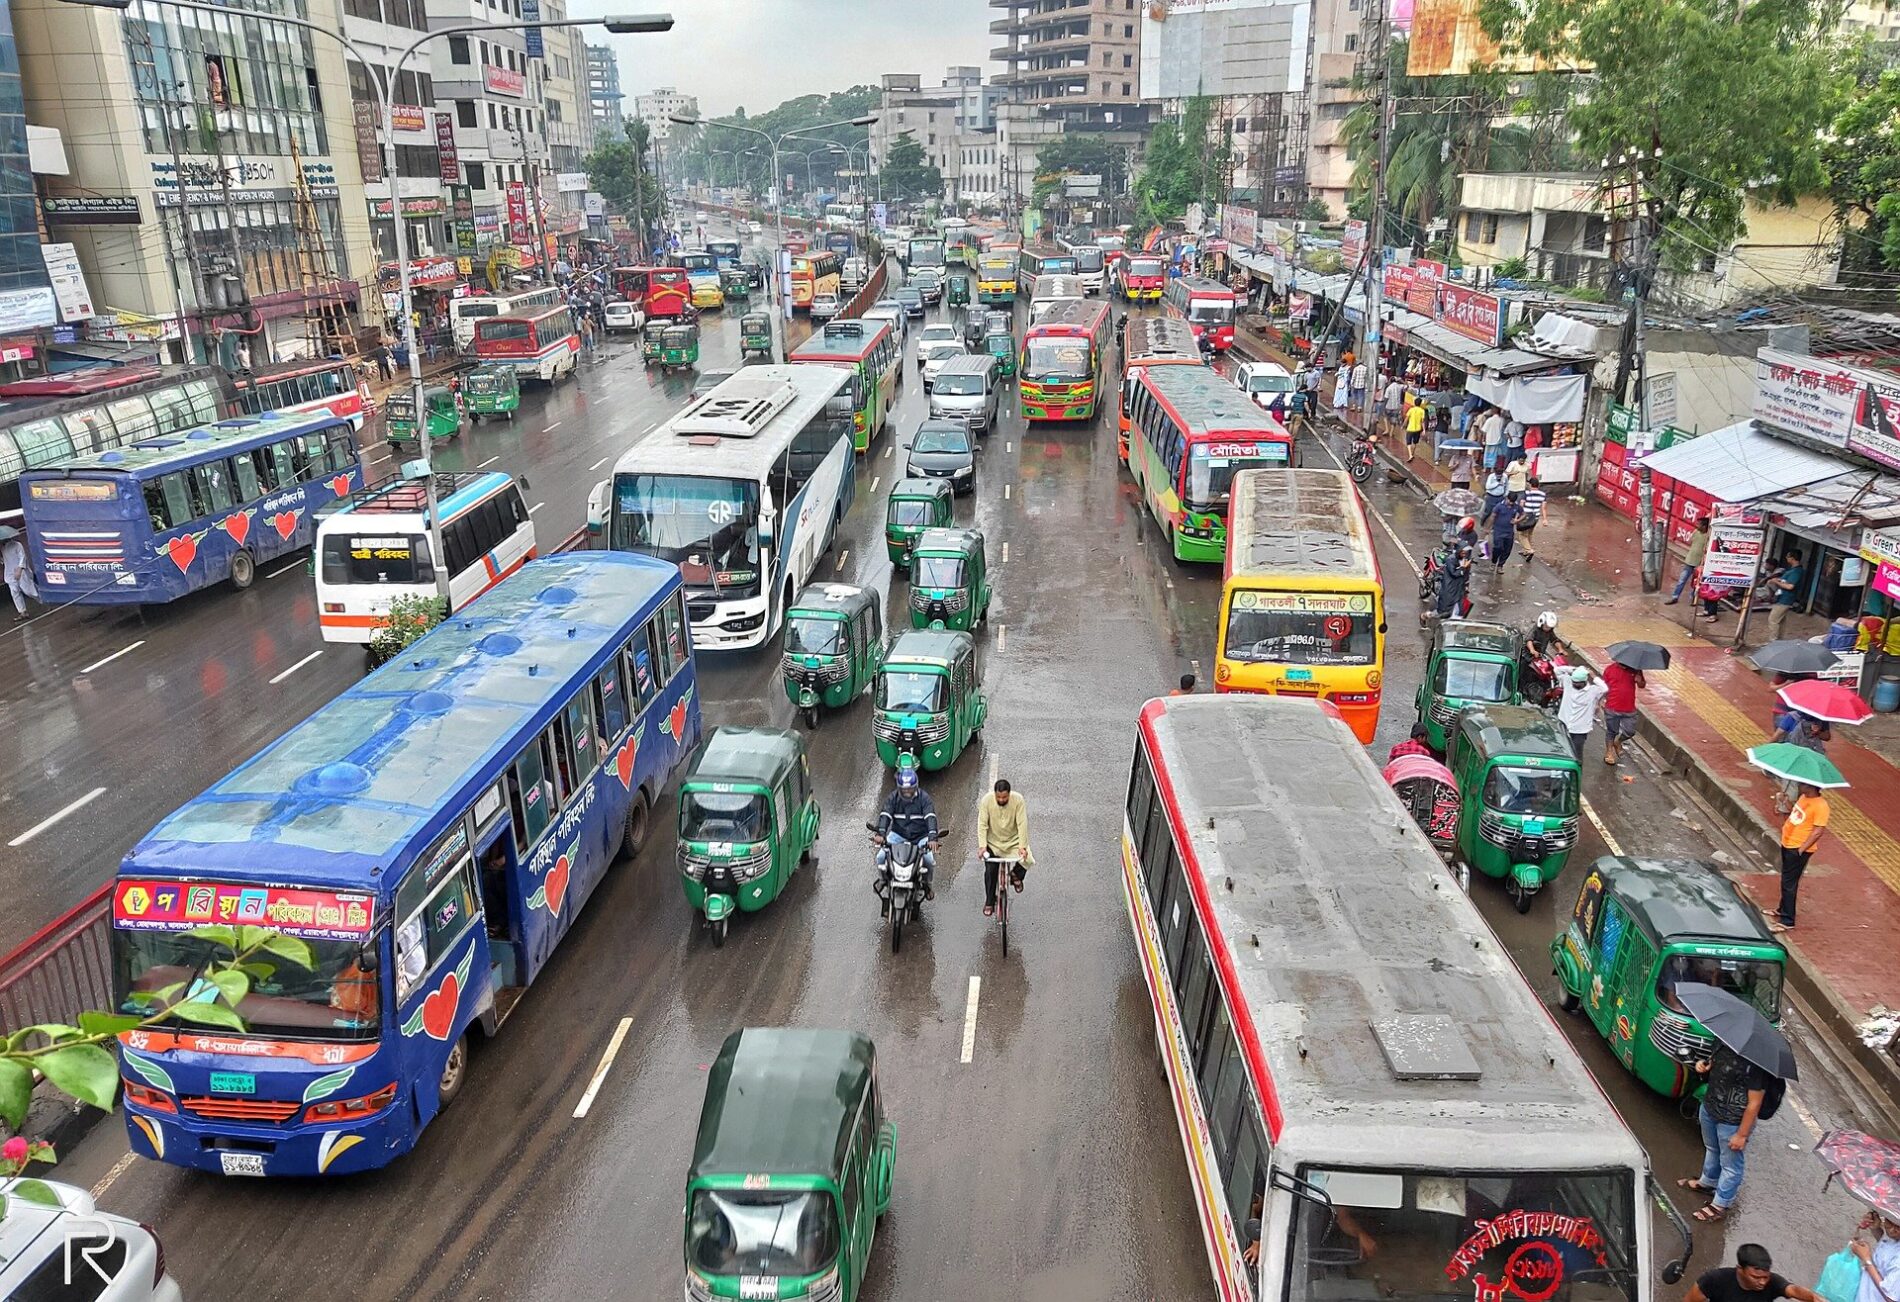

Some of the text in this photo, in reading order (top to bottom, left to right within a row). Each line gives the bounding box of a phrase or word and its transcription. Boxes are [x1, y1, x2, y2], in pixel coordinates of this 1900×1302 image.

[708, 500, 732, 523] SR
[1872, 533, 1893, 553] Green
[45, 562, 76, 572] পরিস্থান
[79, 561, 108, 571] পরিবহন
[718, 574, 730, 582] SR
[1260, 596, 1347, 609] গাবতলী ৭ সদরঘাট
[528, 831, 557, 876] পরিস্থান
[557, 804, 586, 839] পরিবহন
[157, 887, 262, 919] পরিস্থান
[267, 898, 313, 923] পরিবহন
[347, 899, 367, 928] লিঃ
